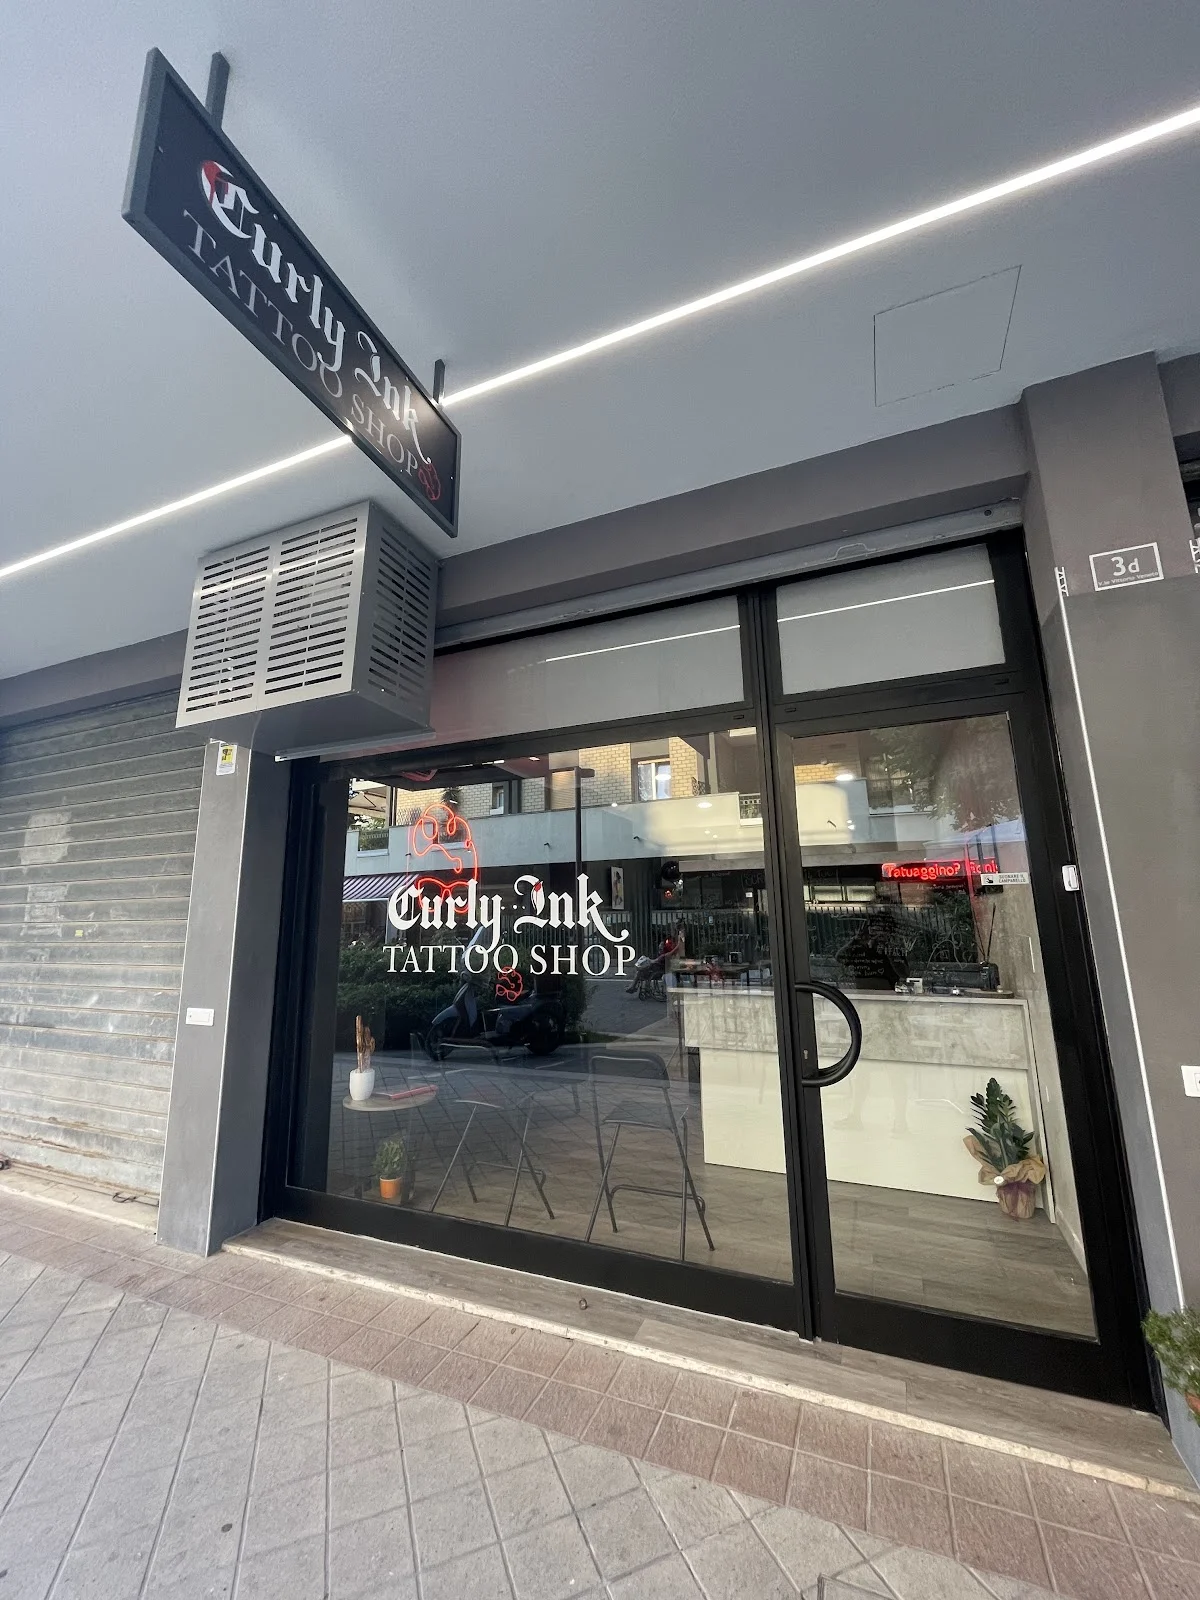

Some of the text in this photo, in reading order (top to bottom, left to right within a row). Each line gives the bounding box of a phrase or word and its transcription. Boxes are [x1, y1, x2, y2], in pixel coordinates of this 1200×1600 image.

[183, 209, 419, 476] TATTOO SHOP
[201, 160, 432, 465] Curly Ink
[1111, 556, 1140, 576] 3d
[388, 872, 630, 954] Curly Ink
[383, 944, 636, 976] TATTOO SHOP
